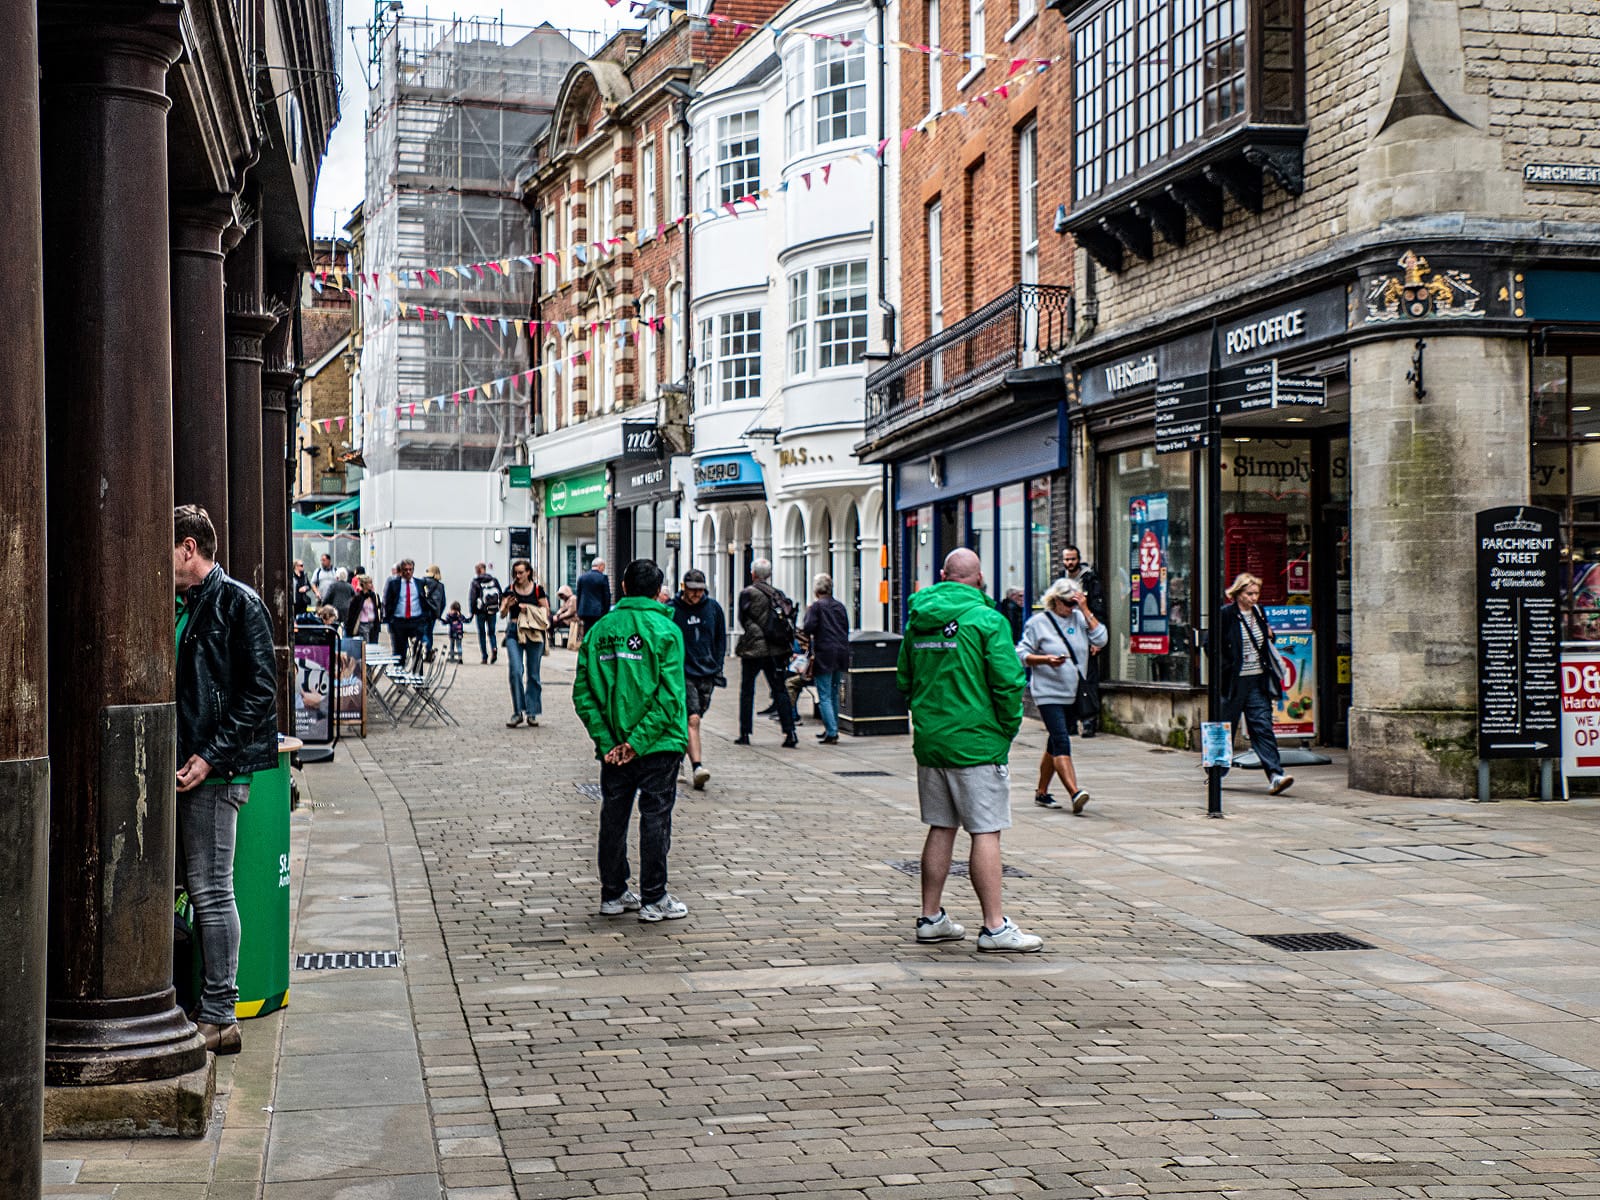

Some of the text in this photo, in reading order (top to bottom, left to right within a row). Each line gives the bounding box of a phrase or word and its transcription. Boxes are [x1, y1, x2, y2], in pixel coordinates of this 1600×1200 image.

[1226, 309, 1305, 355] POST OFFICE
[1105, 355, 1158, 393] WHSmith
[695, 463, 740, 486] NERO
[1233, 456, 1312, 482] Simply
[1482, 538, 1555, 550] PARCHMENT
[1497, 552, 1540, 564] STREET
[1576, 715, 1594, 726] WE
